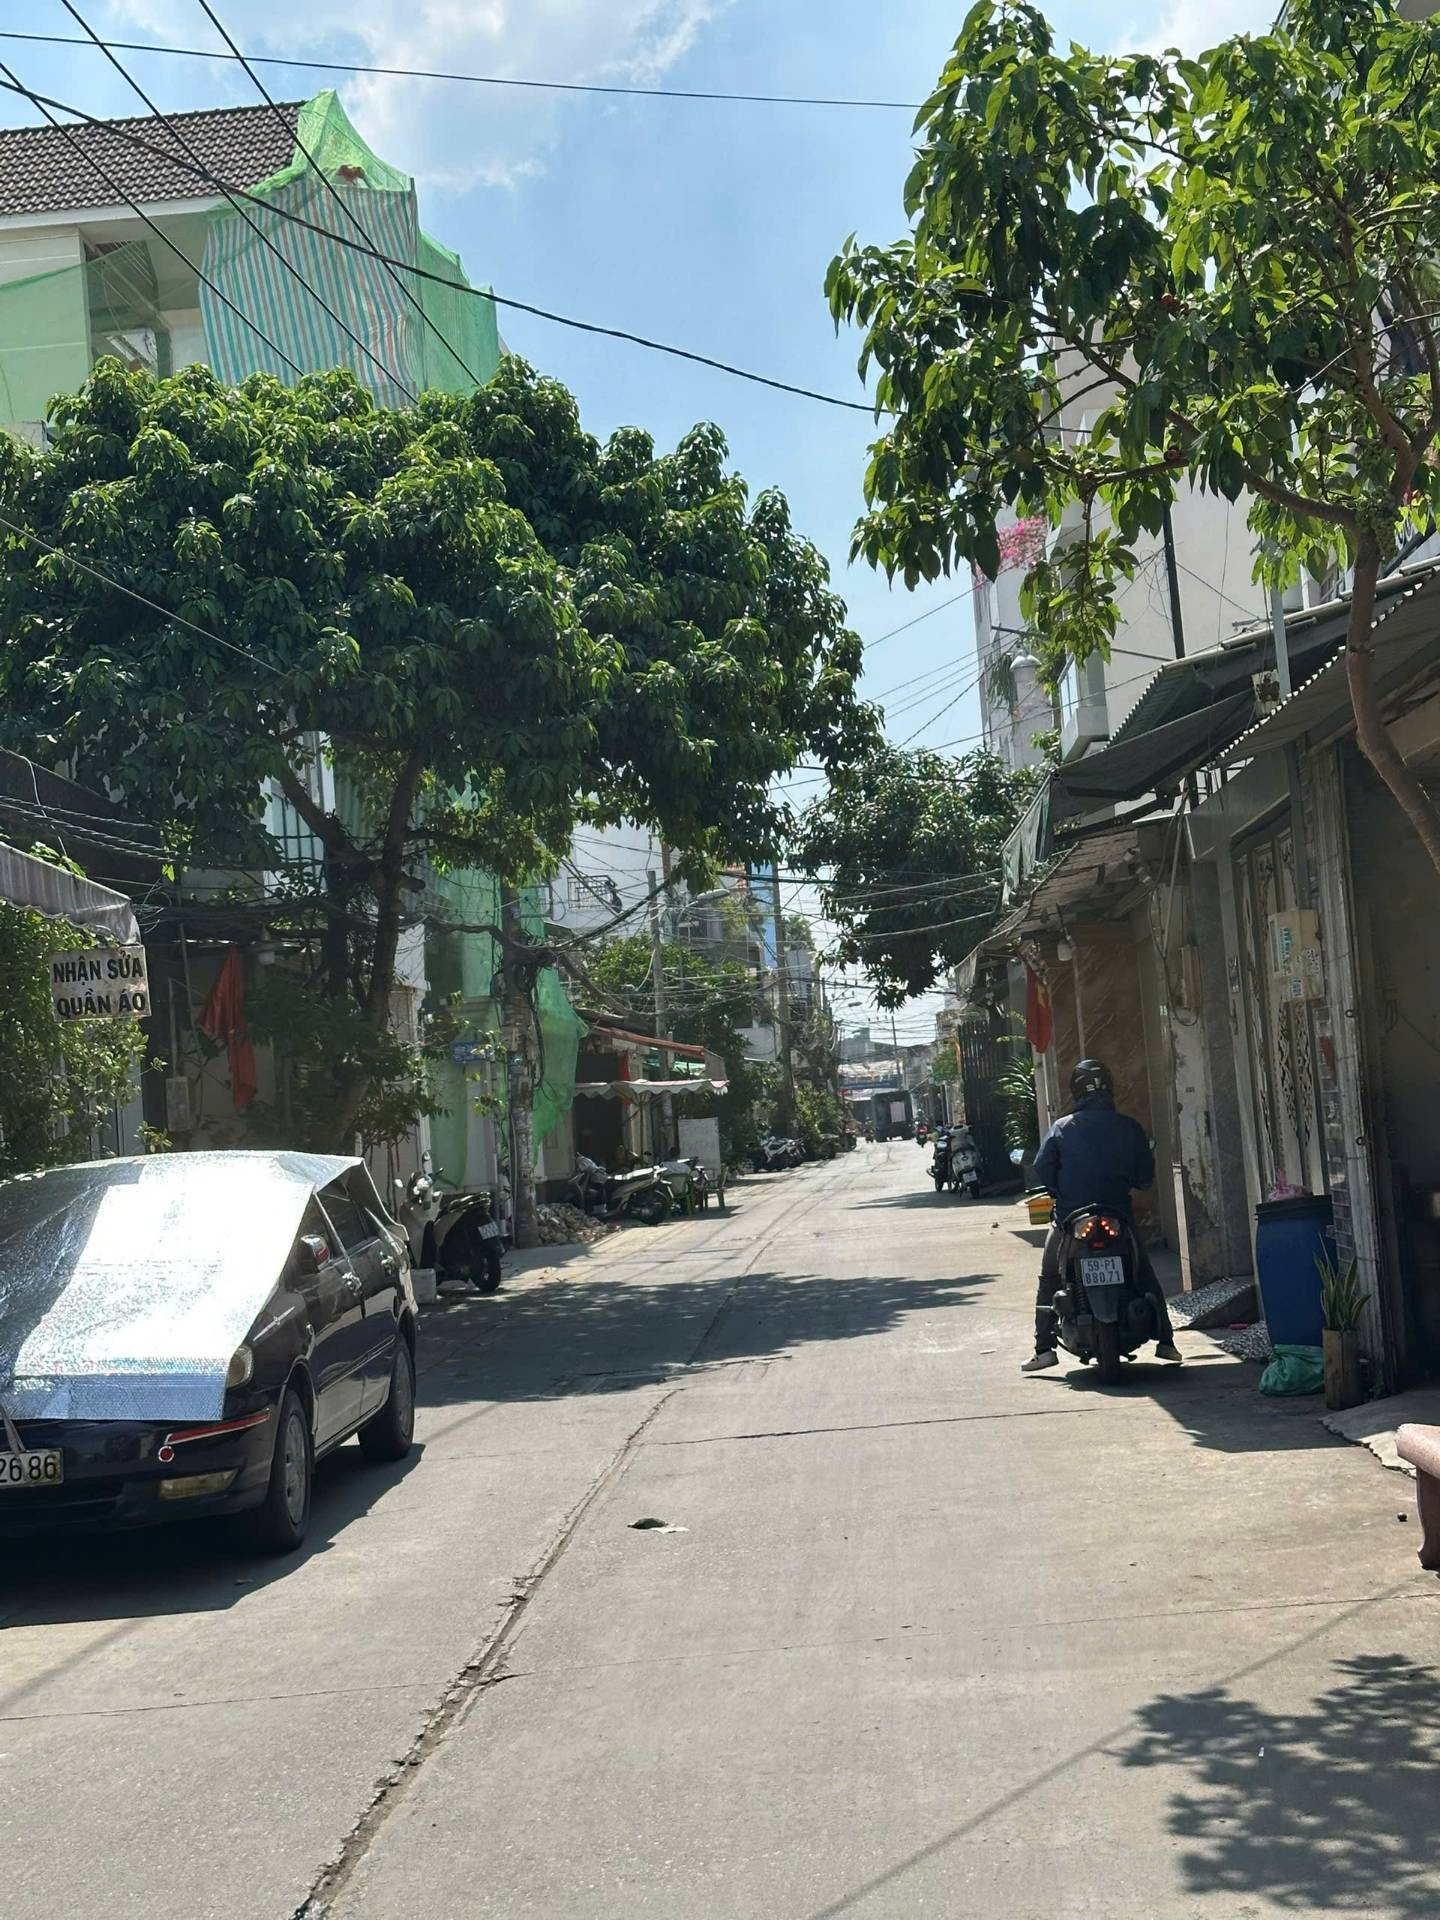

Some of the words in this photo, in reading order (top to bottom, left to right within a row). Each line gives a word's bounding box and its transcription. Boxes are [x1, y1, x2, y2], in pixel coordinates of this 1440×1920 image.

[53, 955, 102, 986] NHẬN
[107, 950, 143, 980] SỬA
[56, 988, 111, 1019] QUẦN
[119, 989, 146, 1013] ÁO
[1087, 1258, 1115, 1271] 59-P1
